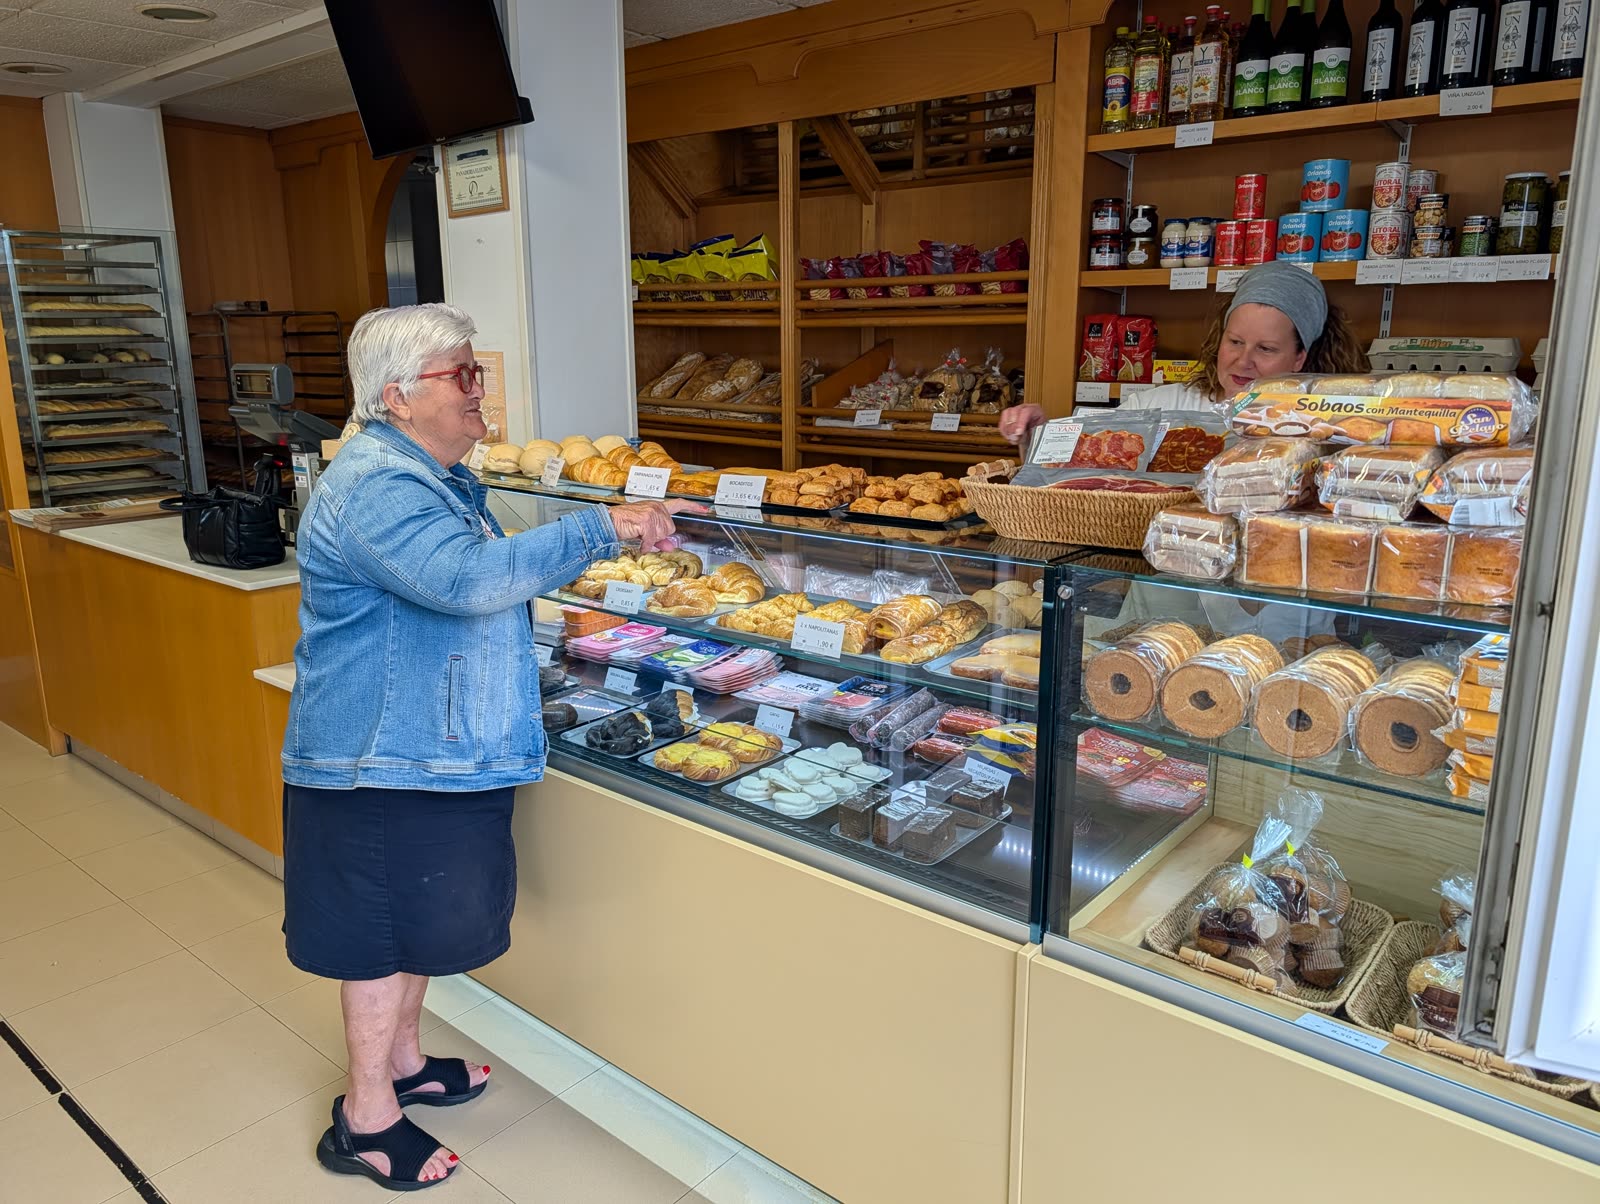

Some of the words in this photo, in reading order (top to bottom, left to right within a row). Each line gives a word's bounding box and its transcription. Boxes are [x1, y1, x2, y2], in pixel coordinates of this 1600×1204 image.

[1314, 76, 1346, 84] BLANCO
[1269, 82, 1300, 90] BLANCO
[1235, 87, 1264, 96] BLANCO
[1375, 178, 1402, 186] LITORAL
[1295, 398, 1365, 414] Sobaos
[1386, 407, 1457, 418] Mantequilla
[1466, 414, 1492, 425] San
[1450, 422, 1508, 437] Pelayo
[809, 624, 838, 636] NAPOLITANAS
[817, 640, 829, 648] 1,90
